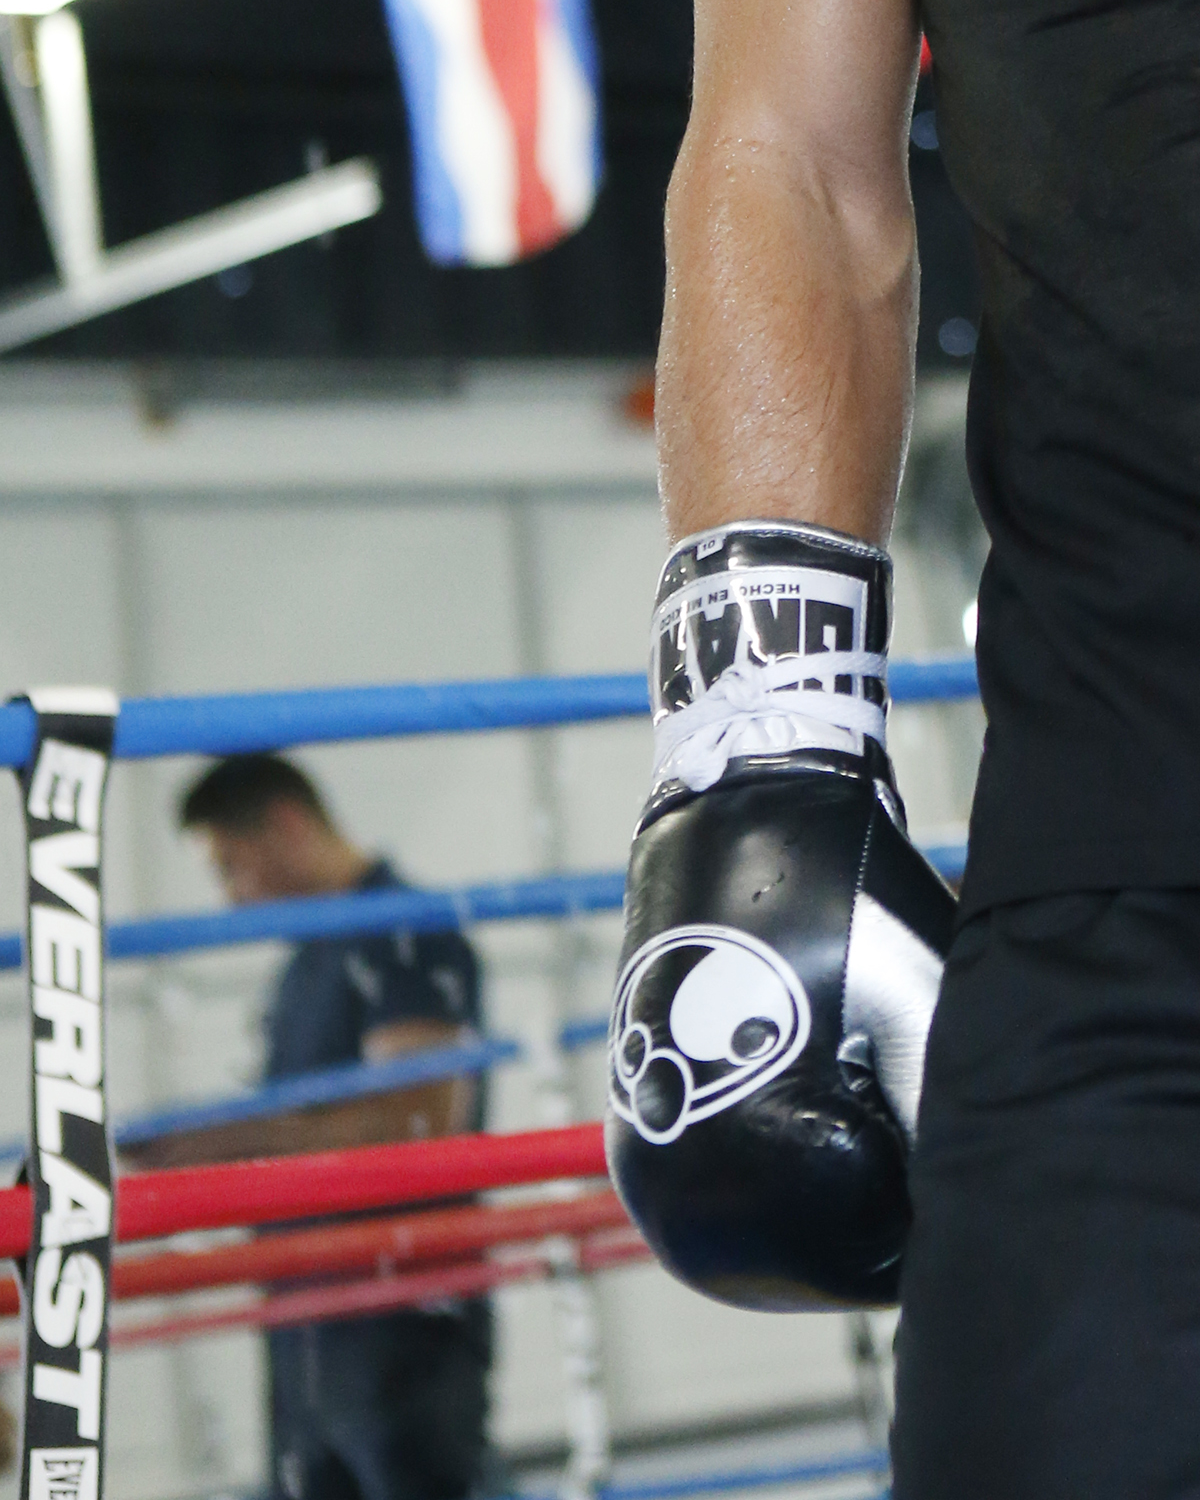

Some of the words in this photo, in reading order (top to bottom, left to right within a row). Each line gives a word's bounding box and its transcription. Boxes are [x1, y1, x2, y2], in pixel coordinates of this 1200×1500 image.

[708, 589, 729, 604] EN
[659, 597, 703, 631] MXICO
[29, 740, 112, 1440] EVERLAST
